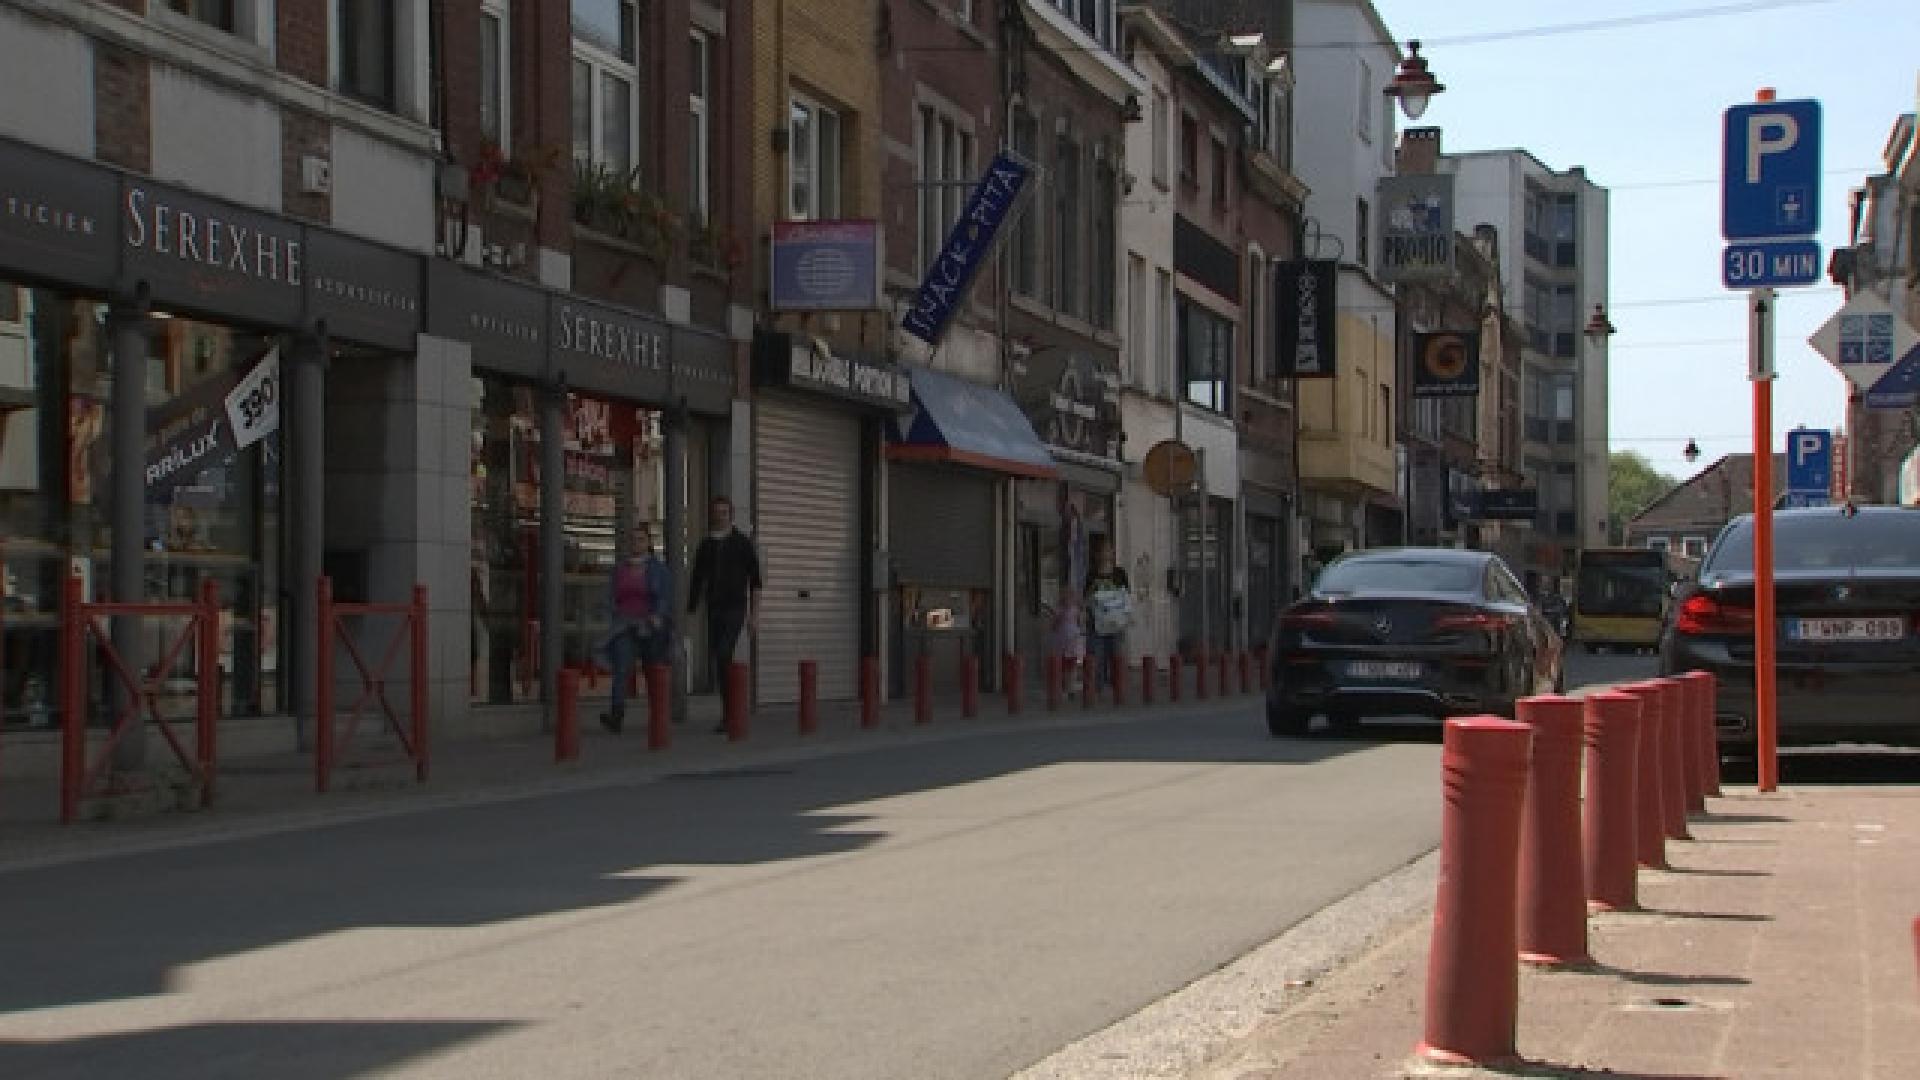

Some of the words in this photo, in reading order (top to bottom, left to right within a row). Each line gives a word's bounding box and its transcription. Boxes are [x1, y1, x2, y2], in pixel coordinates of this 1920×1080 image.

[1746, 114, 1798, 183] P
[127, 188, 301, 286] SEREXHE
[1728, 251, 1766, 280] 30
[1773, 253, 1816, 277] MIN
[559, 305, 662, 370] SEREXHE
[1799, 434, 1822, 466] P
